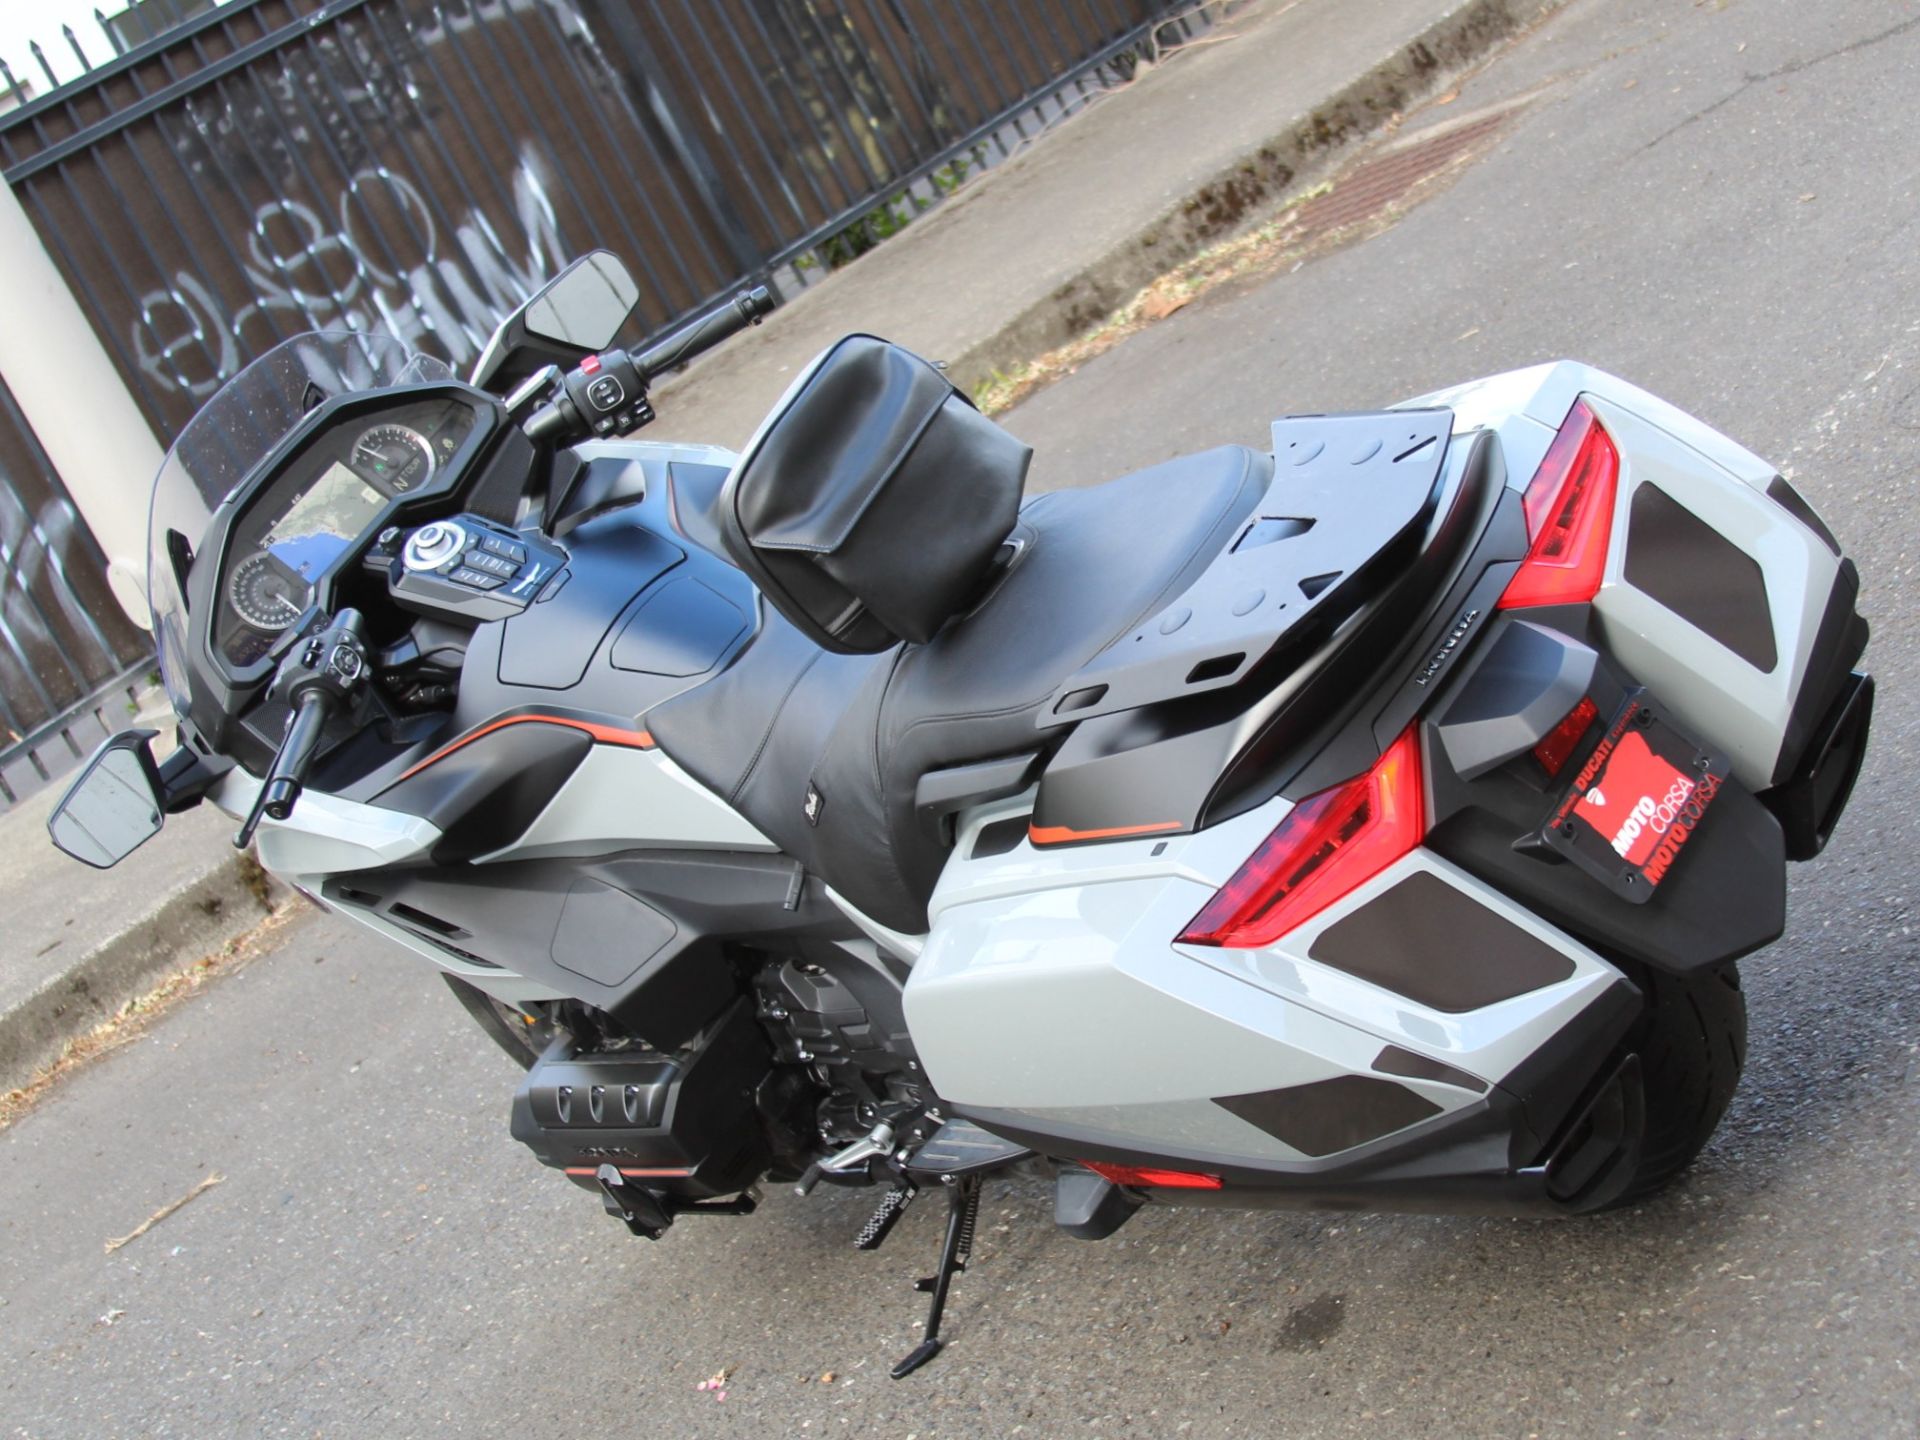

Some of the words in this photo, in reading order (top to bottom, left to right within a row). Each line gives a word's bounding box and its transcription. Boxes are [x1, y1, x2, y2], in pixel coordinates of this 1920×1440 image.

[1416, 609, 1480, 687] HONDA
[1574, 739, 1613, 792] DUCATI
[1611, 796, 1656, 858] MOTO
[1649, 777, 1695, 833] CORSA
